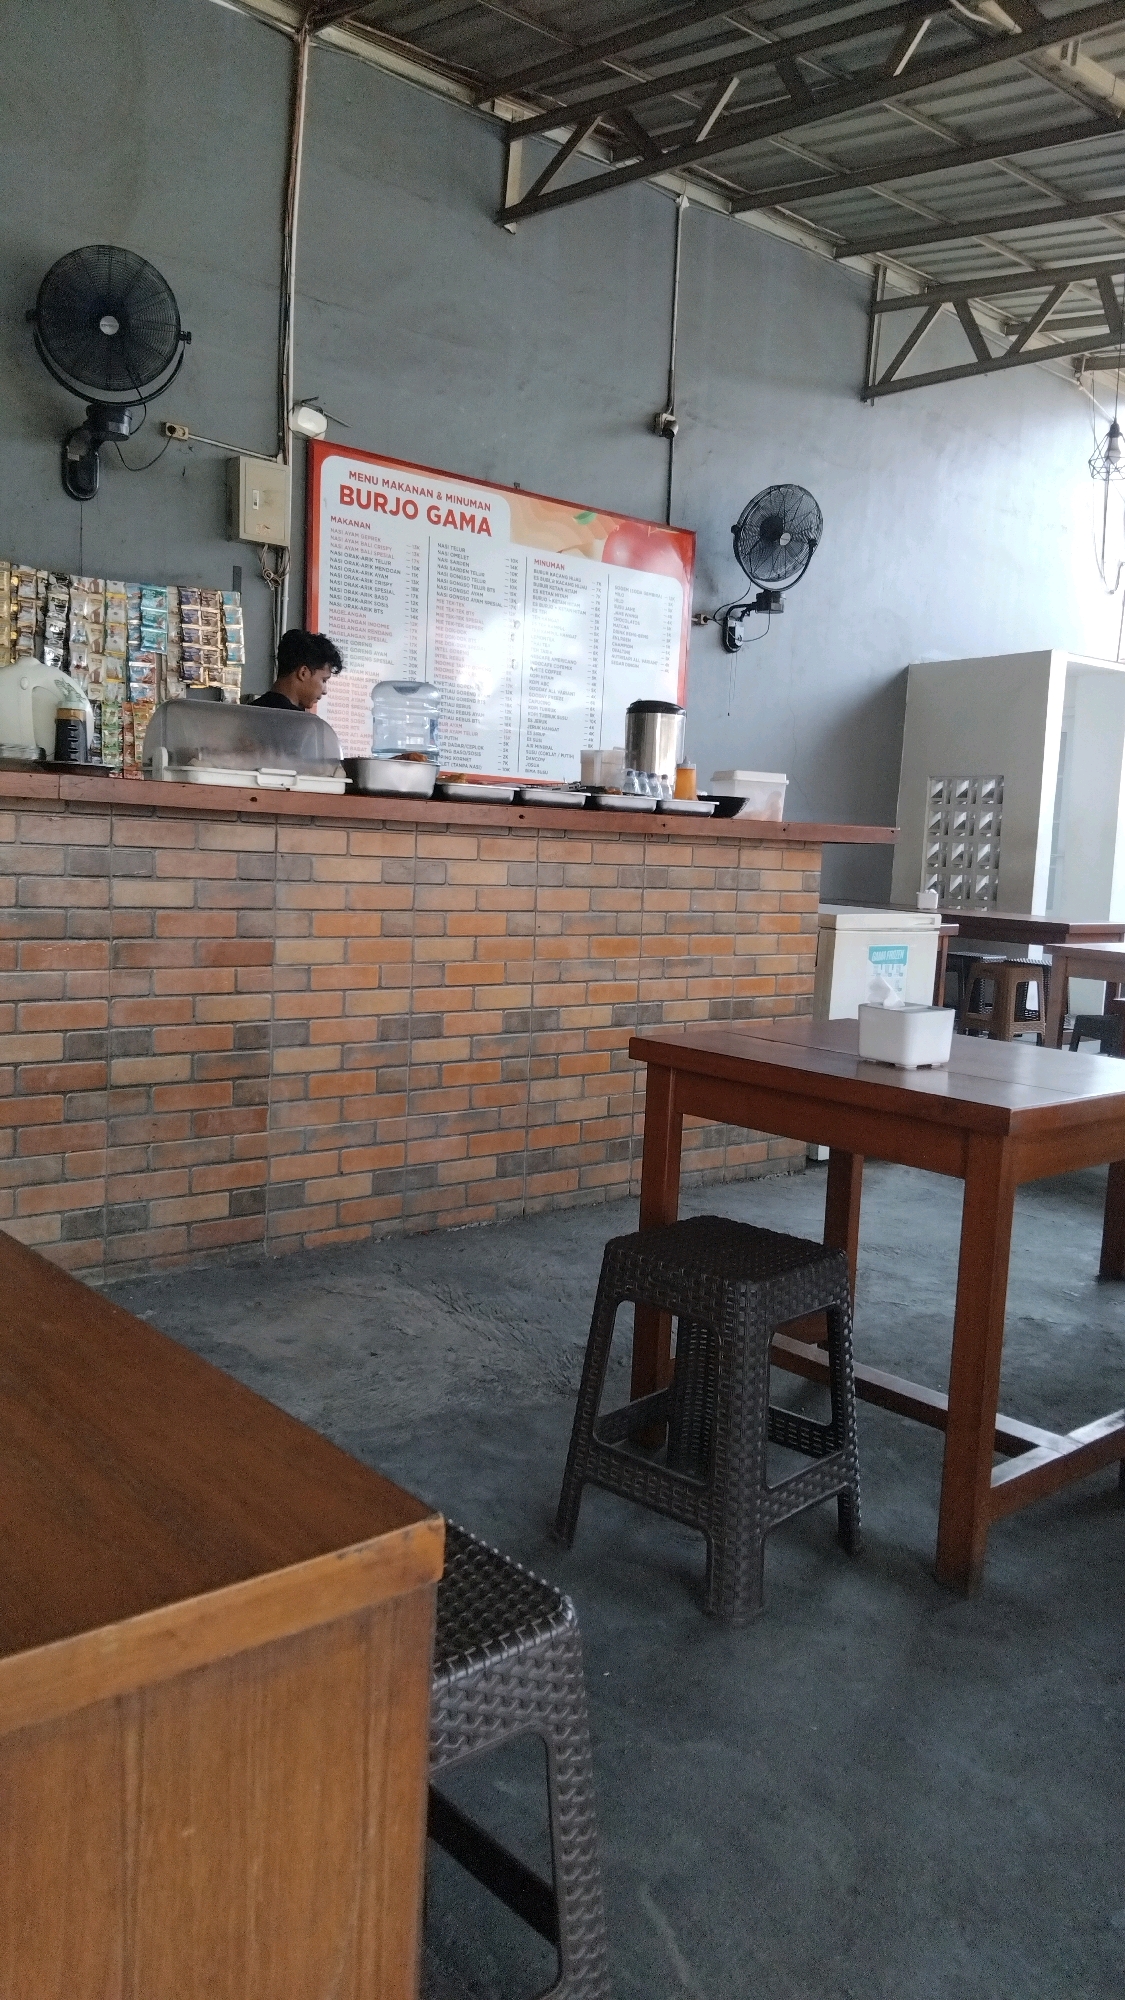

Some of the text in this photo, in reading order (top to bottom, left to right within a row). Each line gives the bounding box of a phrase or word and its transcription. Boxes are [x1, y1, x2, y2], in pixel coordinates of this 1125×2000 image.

[349, 470, 491, 512] MENU MAKANAN & MINUMAN
[330, 516, 371, 530] MAKANAN
[340, 484, 492, 537] BURJO GAMA
[534, 559, 565, 571] MINUMAN
